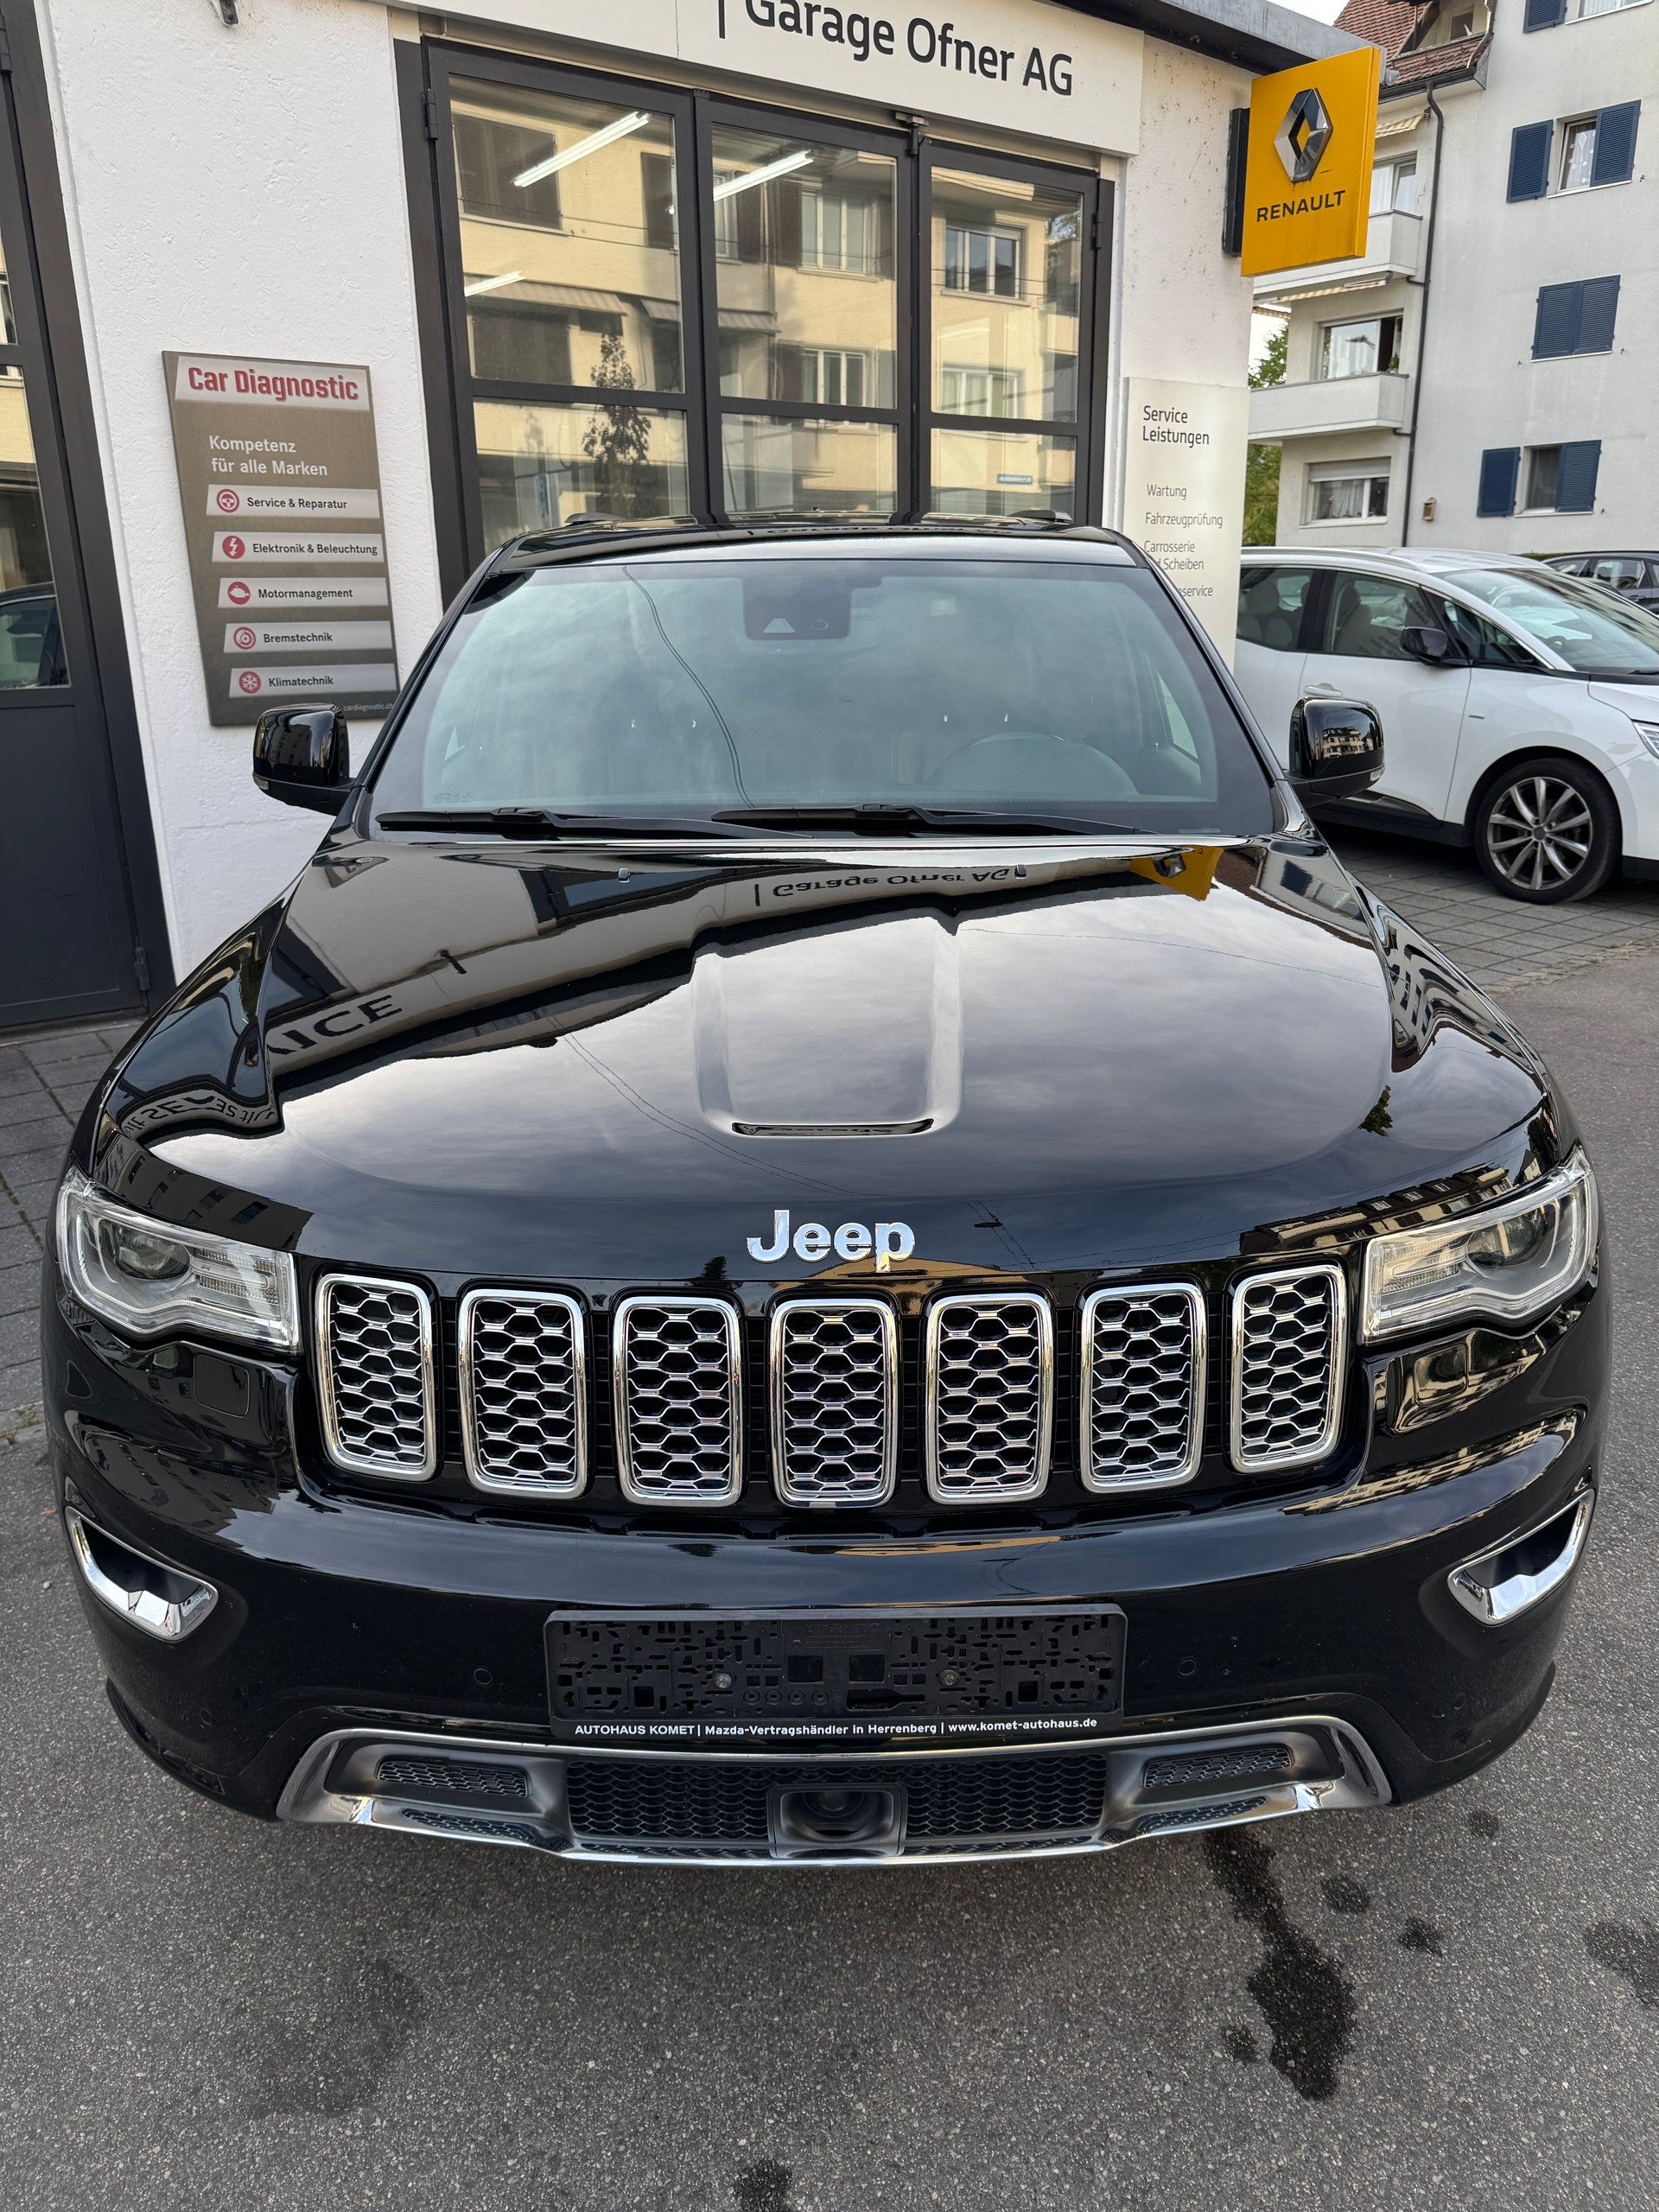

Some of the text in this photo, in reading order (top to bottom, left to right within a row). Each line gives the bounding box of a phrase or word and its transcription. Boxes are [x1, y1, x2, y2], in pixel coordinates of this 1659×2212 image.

[907, 17, 1014, 81] Ofner
[1022, 48, 1073, 96] AG
[1255, 190, 1346, 223] RENAULT
[188, 366, 359, 402] Car Diagnostic
[1143, 404, 1189, 423] Service
[209, 435, 296, 454] Kompetenz
[1141, 425, 1211, 448] Leistungen
[211, 457, 328, 476] für alle Marken
[1146, 484, 1187, 501] Wartung
[246, 497, 347, 510] Service & Reparatur
[1145, 512, 1224, 530] Fahrzeugprüfung
[252, 543, 378, 556] Elektronik & Beleuchtung
[1143, 540, 1196, 553] Carrosserie
[1163, 557, 1205, 570] Scheiben
[257, 588, 353, 601] Motormanagement
[1177, 584, 1213, 598] service
[264, 632, 334, 643] Bremstechnik
[269, 676, 334, 687] Klimatechnik
[746, 1209, 916, 1274] Jeep
[575, 1725, 646, 1735] AUTOHAUS
[649, 1725, 695, 1735] KOMET
[704, 1724, 848, 1737] Mazda-Vertragshändler
[853, 1724, 864, 1734] in
[868, 1723, 937, 1735] Herrenberg
[948, 1718, 1098, 1733] www.komet-autohaus.de
